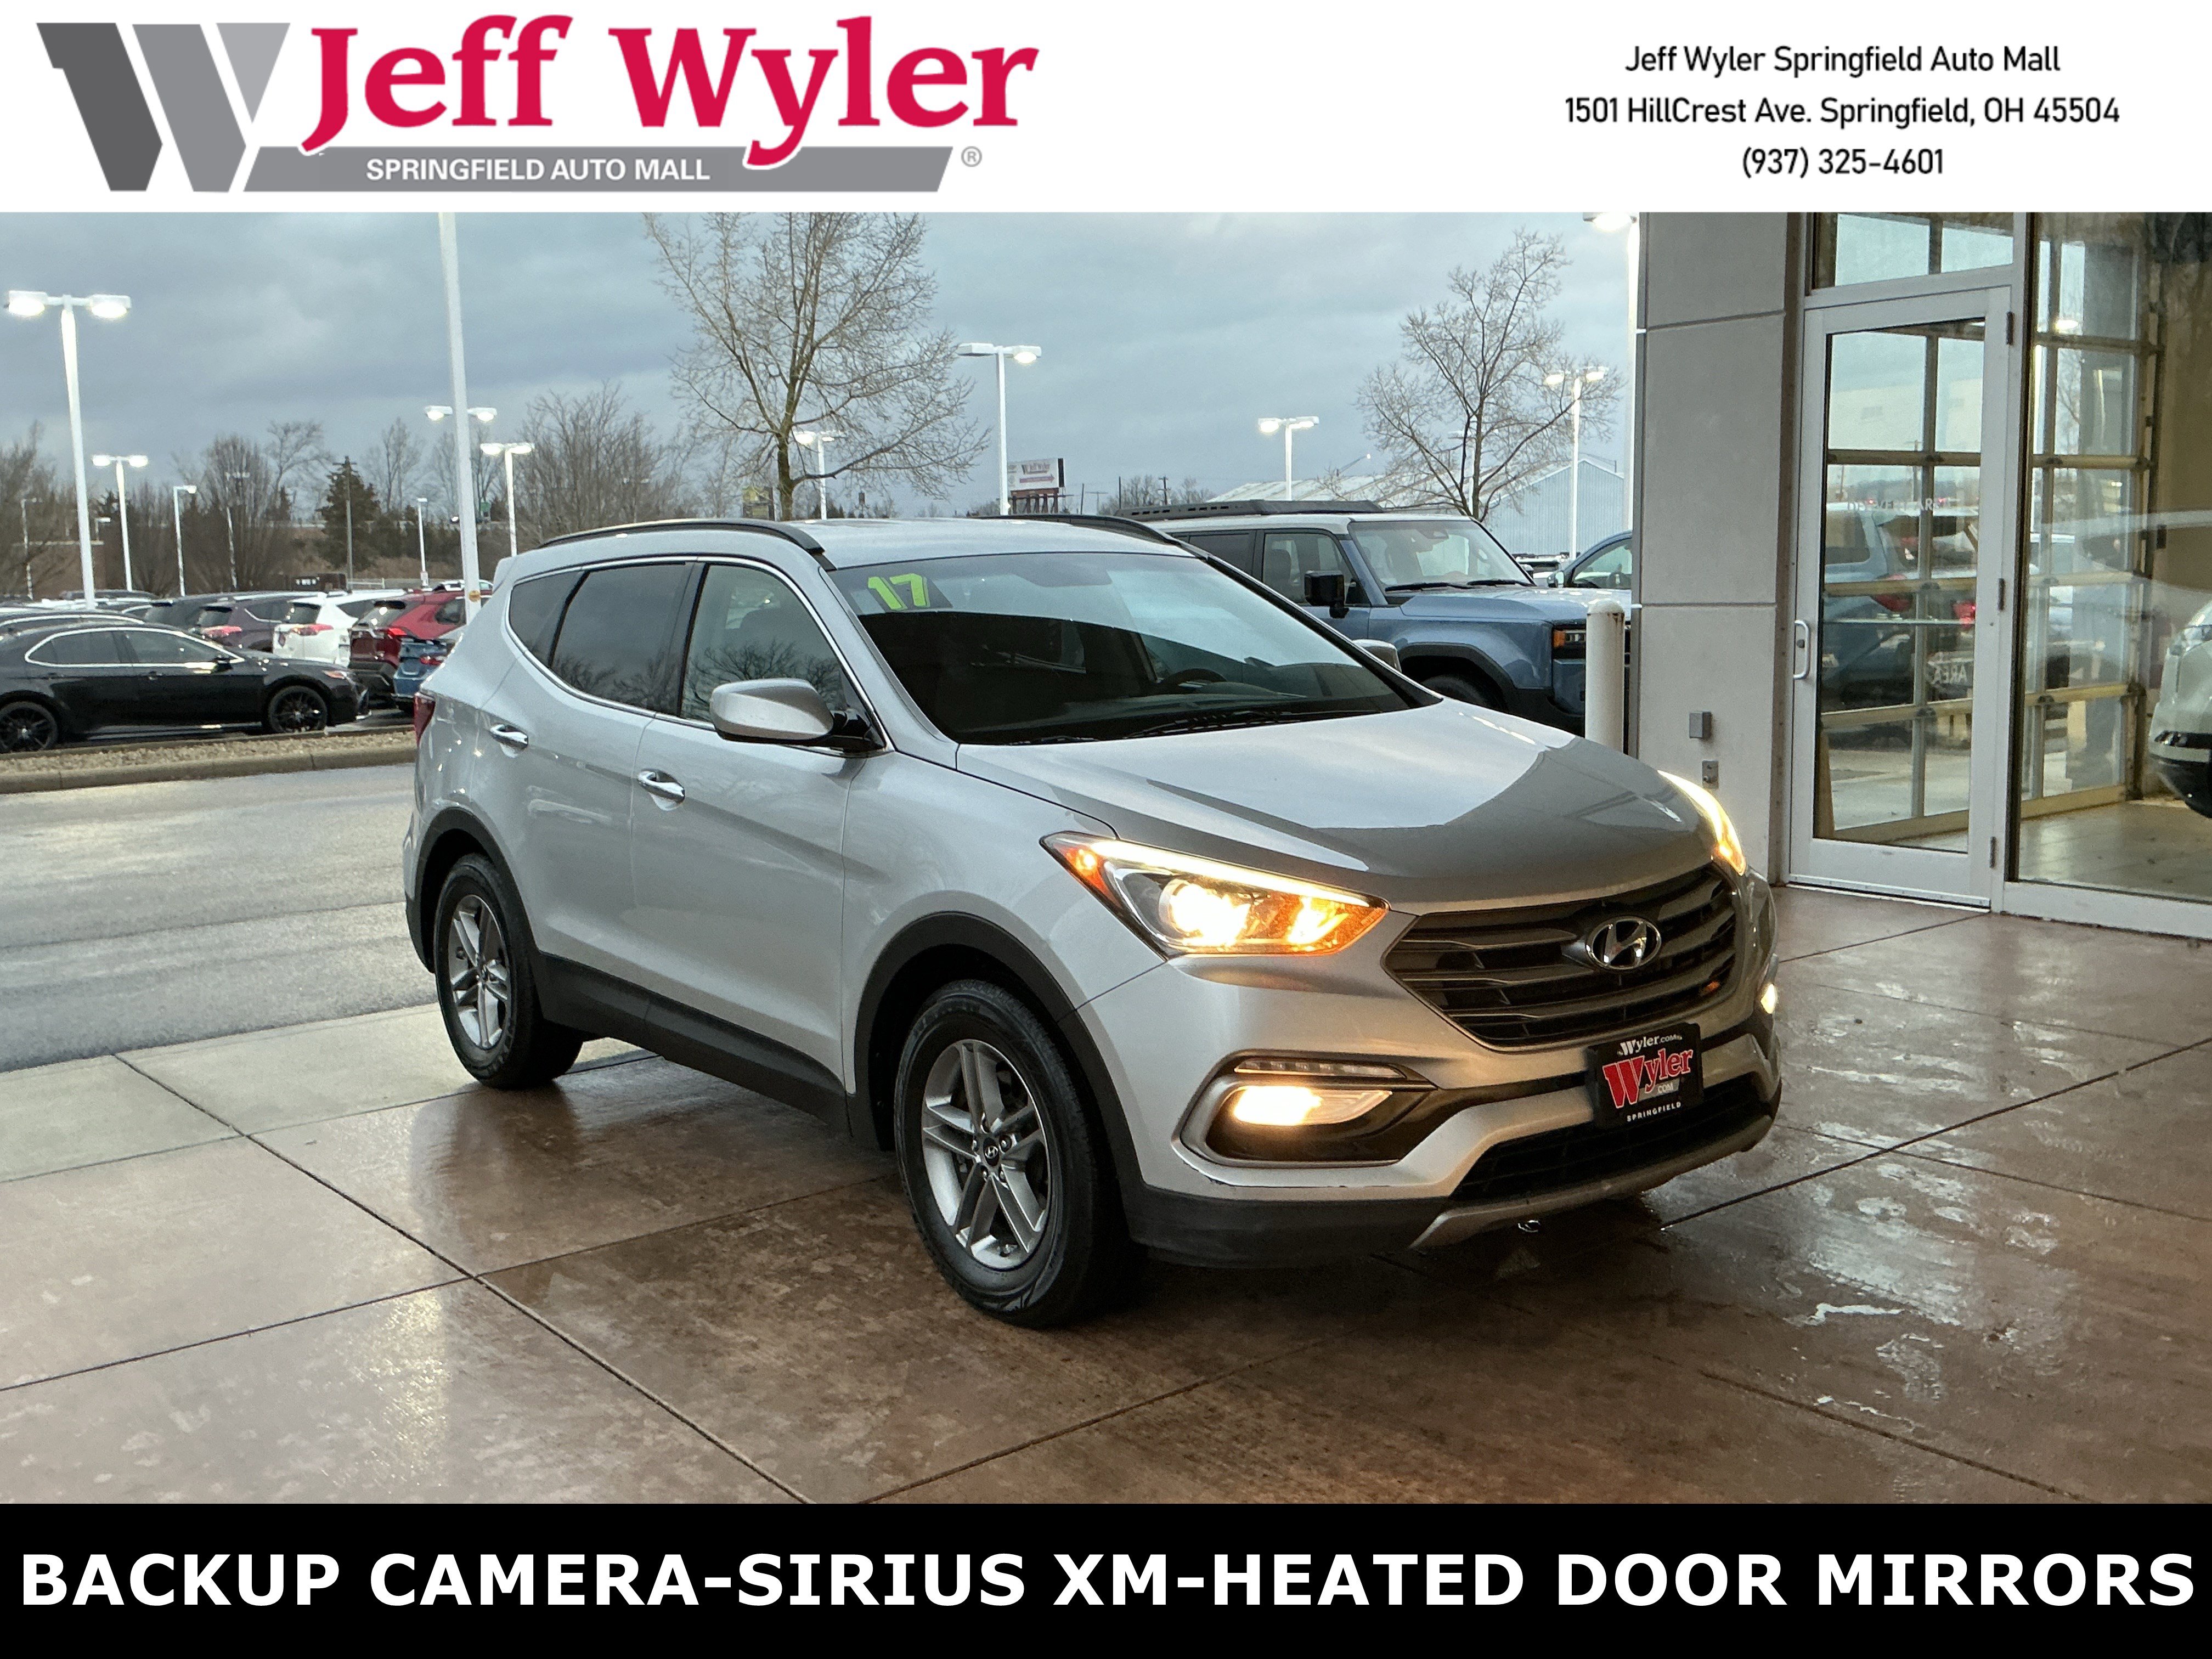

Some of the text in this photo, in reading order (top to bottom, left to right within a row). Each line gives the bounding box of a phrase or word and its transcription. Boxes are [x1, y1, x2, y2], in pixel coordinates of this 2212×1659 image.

[867, 573, 930, 611] 17
[1602, 1047, 1694, 1109] Wyler
[1627, 1101, 1681, 1122] SPRINGFIELD
